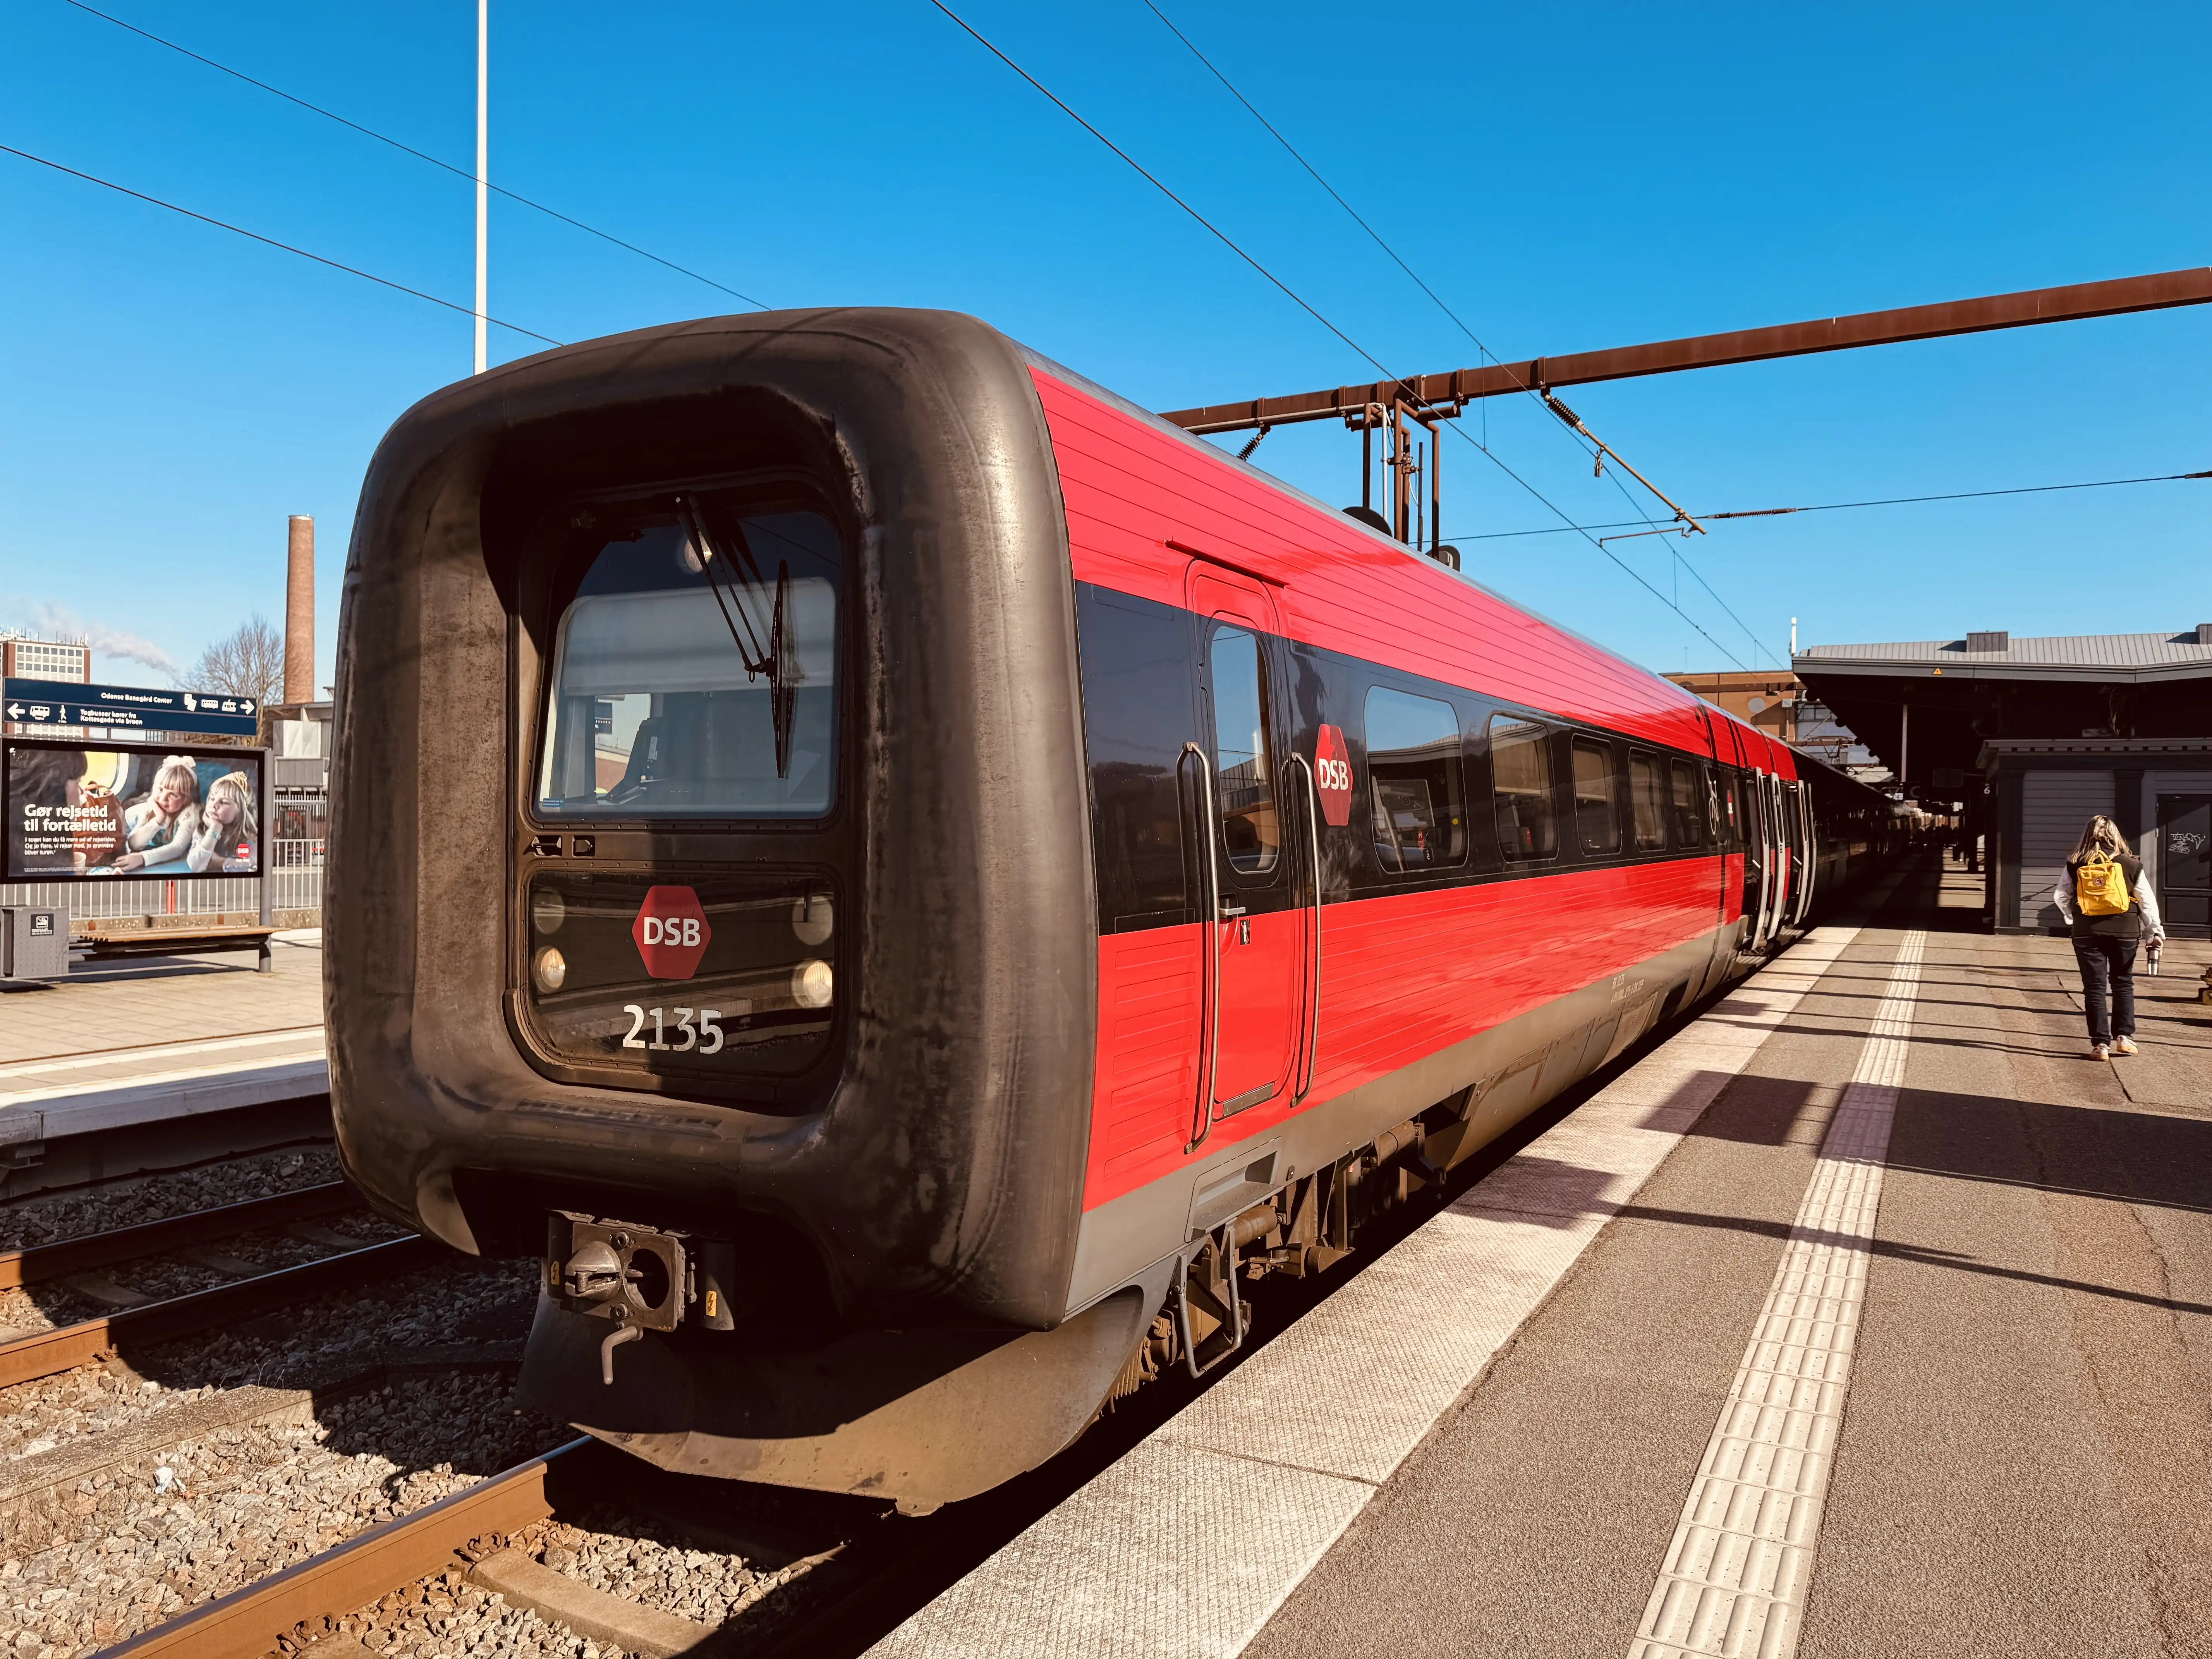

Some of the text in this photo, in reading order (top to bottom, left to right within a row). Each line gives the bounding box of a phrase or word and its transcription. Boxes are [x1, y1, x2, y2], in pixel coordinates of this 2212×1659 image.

[125, 694, 153, 702] Banegård
[80, 715, 114, 723] Kottesgade
[1319, 758, 1348, 790] DSB
[24, 804, 108, 820] Gør rejsetid
[24, 818, 116, 831] til fortælletid
[644, 917, 701, 946] DSB
[623, 1005, 724, 1054] 2135
